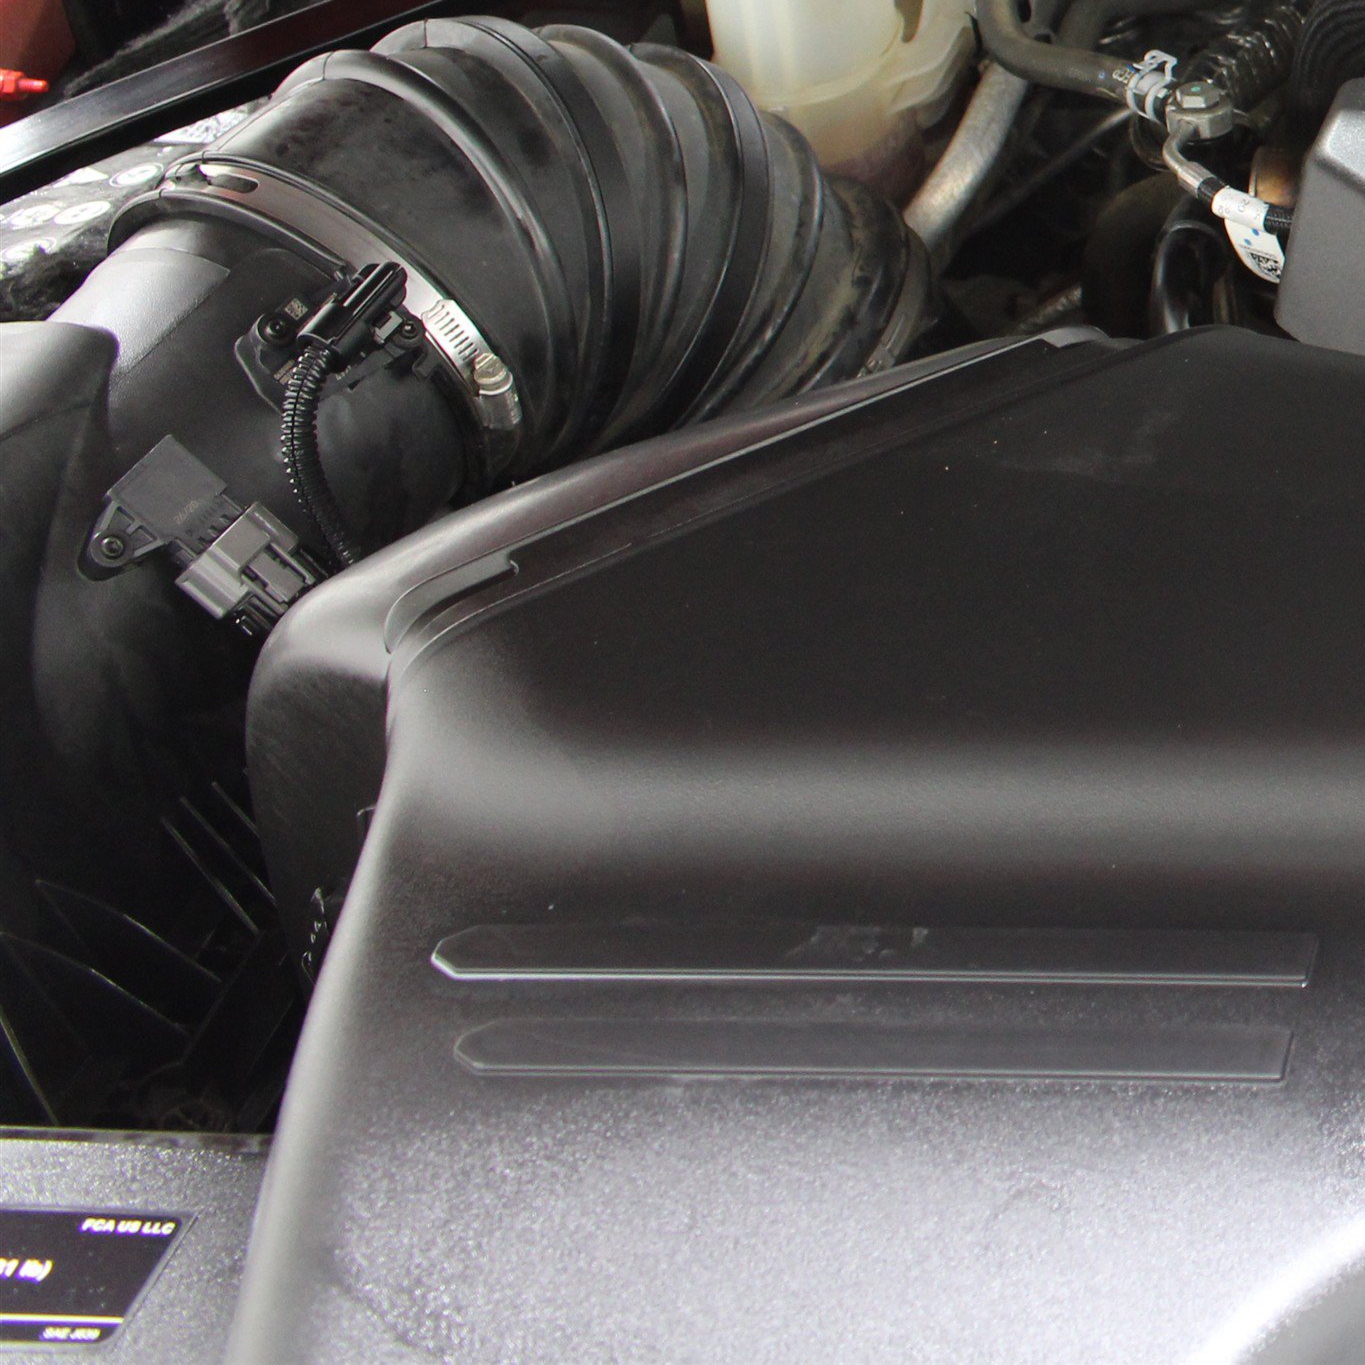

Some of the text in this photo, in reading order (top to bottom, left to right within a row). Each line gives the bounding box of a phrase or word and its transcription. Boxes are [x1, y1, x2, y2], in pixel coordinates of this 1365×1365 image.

[82, 1217, 177, 1235] FCA US LLC
